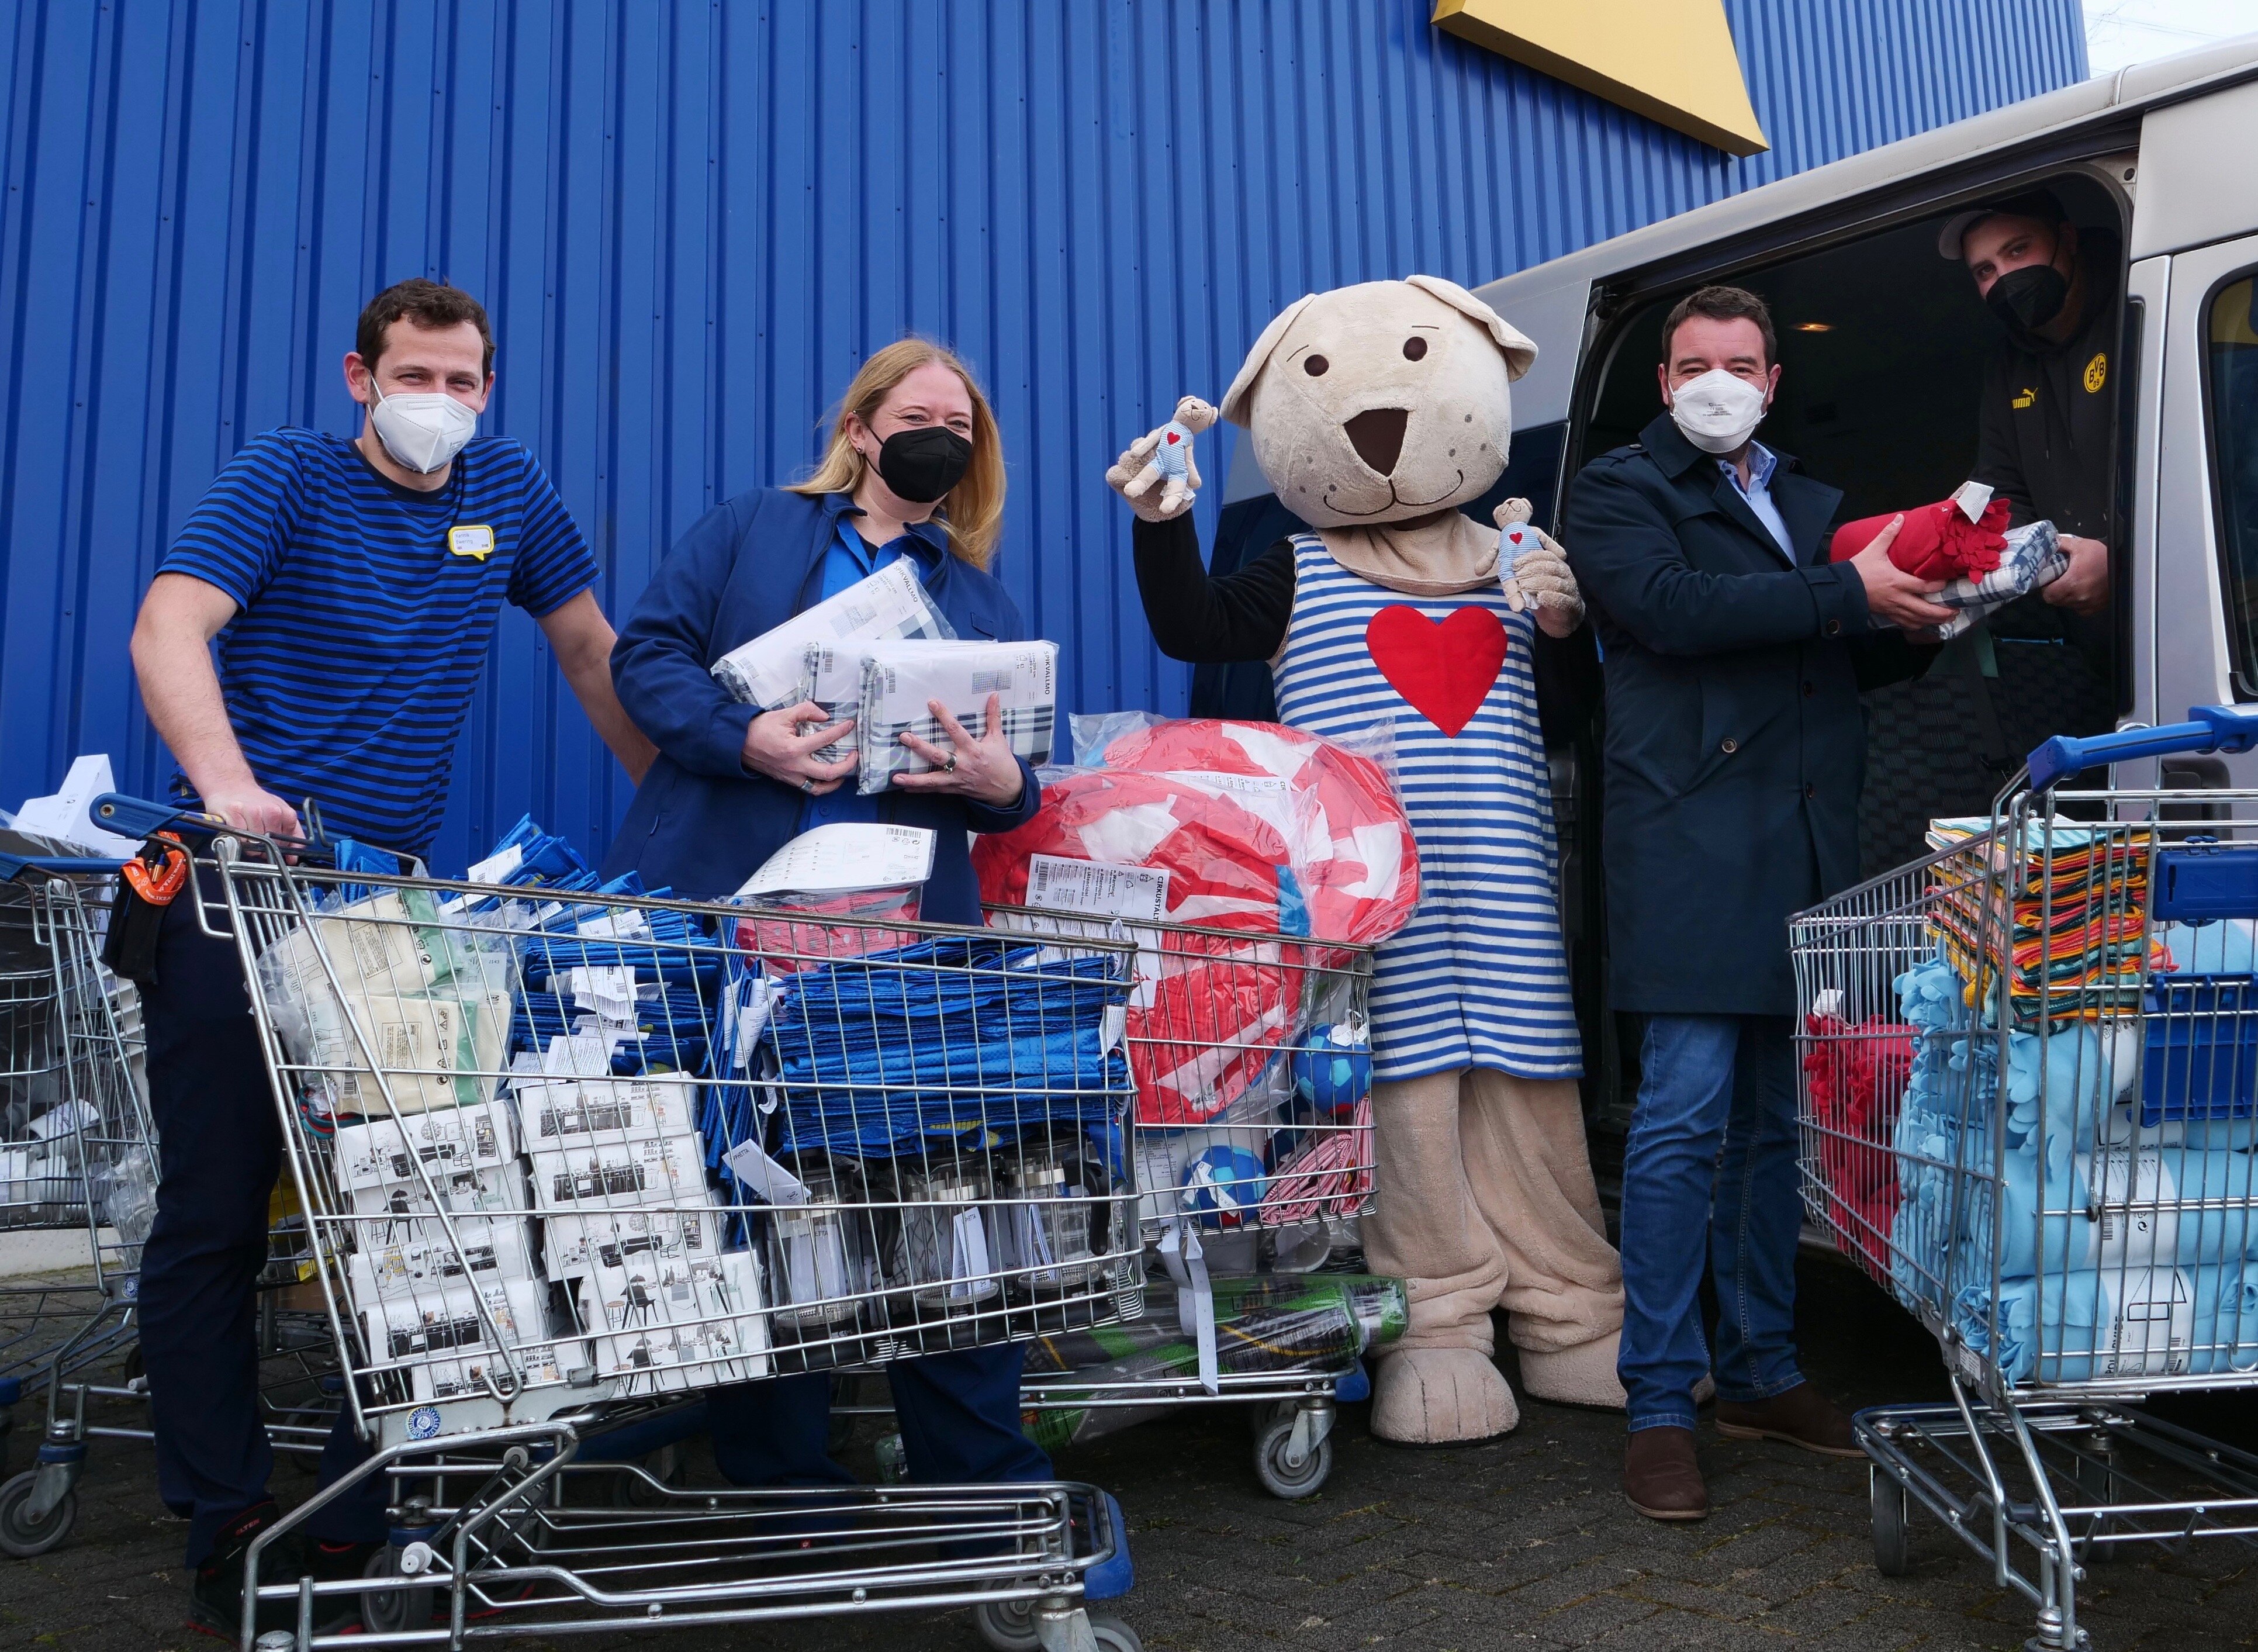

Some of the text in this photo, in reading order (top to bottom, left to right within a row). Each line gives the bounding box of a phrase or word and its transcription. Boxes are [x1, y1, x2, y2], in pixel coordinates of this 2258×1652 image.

[2089, 357, 2104, 383] BVB
[2093, 378, 2100, 389] 09
[894, 565, 918, 603] SPIKVALLMO
[1152, 876, 1164, 920] CIRKUSTÄLT
